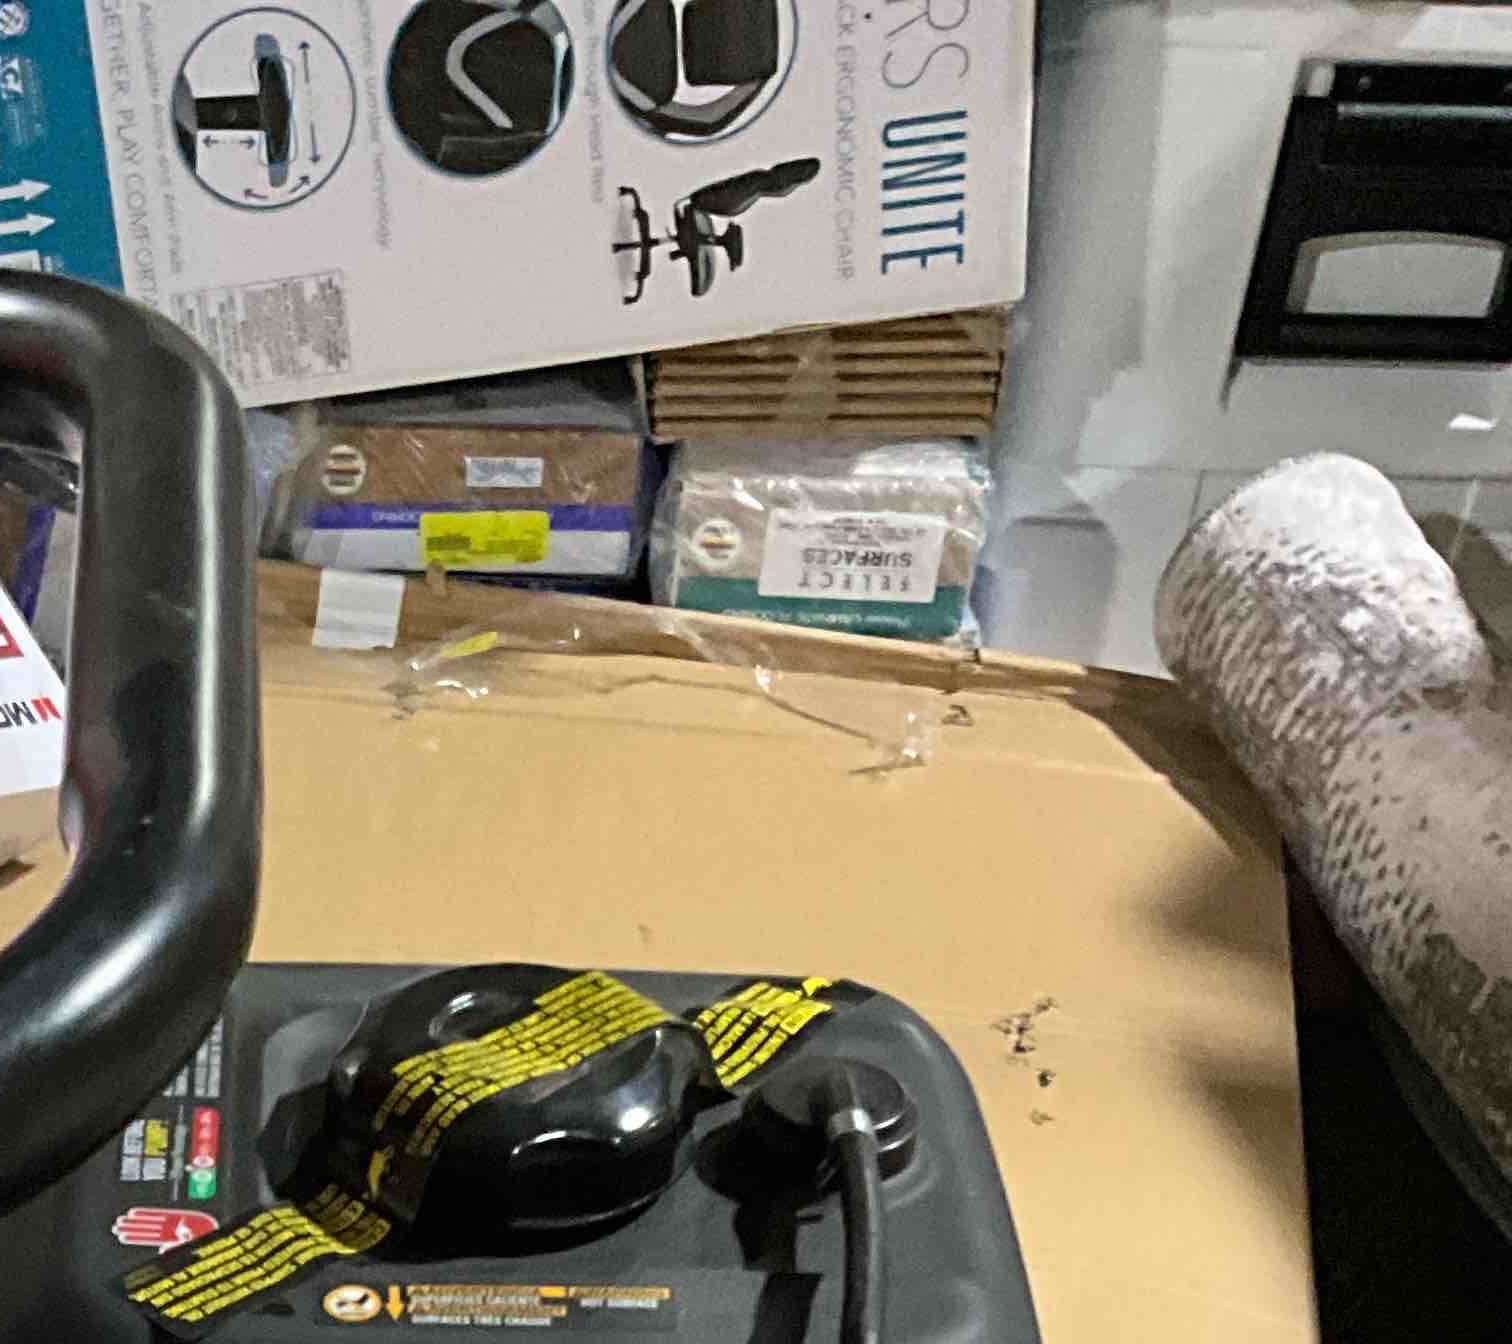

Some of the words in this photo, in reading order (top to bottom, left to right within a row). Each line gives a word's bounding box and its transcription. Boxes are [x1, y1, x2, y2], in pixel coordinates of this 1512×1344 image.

[112, 108, 141, 168] PLAY
[881, 109, 968, 275] UNITE
[800, 548, 913, 571] SURFACES
